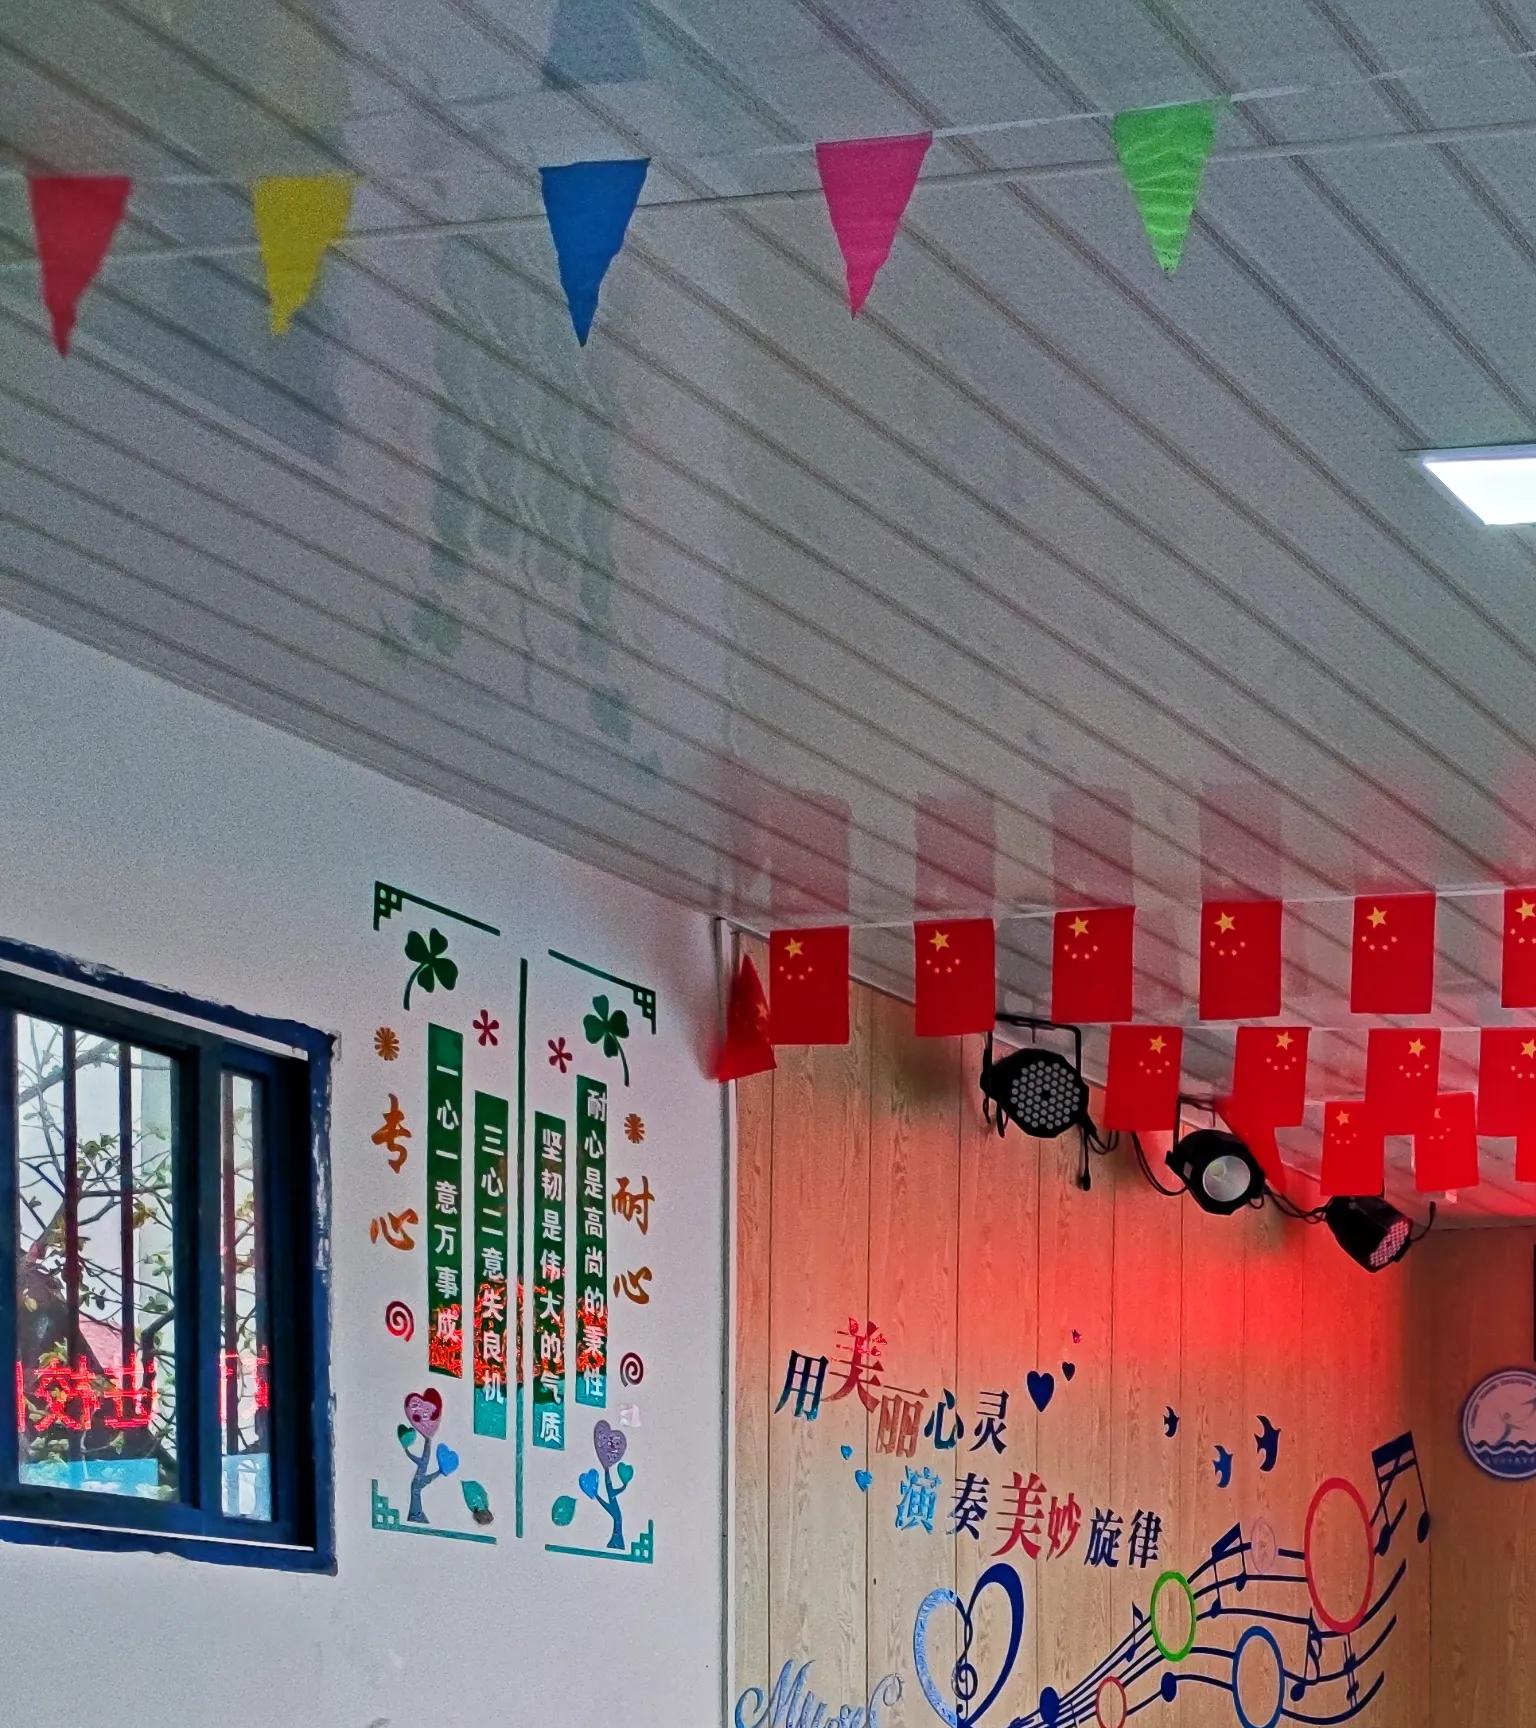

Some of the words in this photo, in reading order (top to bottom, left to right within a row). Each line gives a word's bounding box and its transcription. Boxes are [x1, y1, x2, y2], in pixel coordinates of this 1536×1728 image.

[370, 1092, 419, 1251] 专心
[434, 1064, 461, 1341] 一心一意万事成
[611, 1175, 655, 1305] 耐心
[481, 1123, 507, 1405] 三心二意失良机
[774, 1318, 1011, 1458] 用美丽心灵
[894, 1466, 1163, 1569] 演奏美妙旋律
